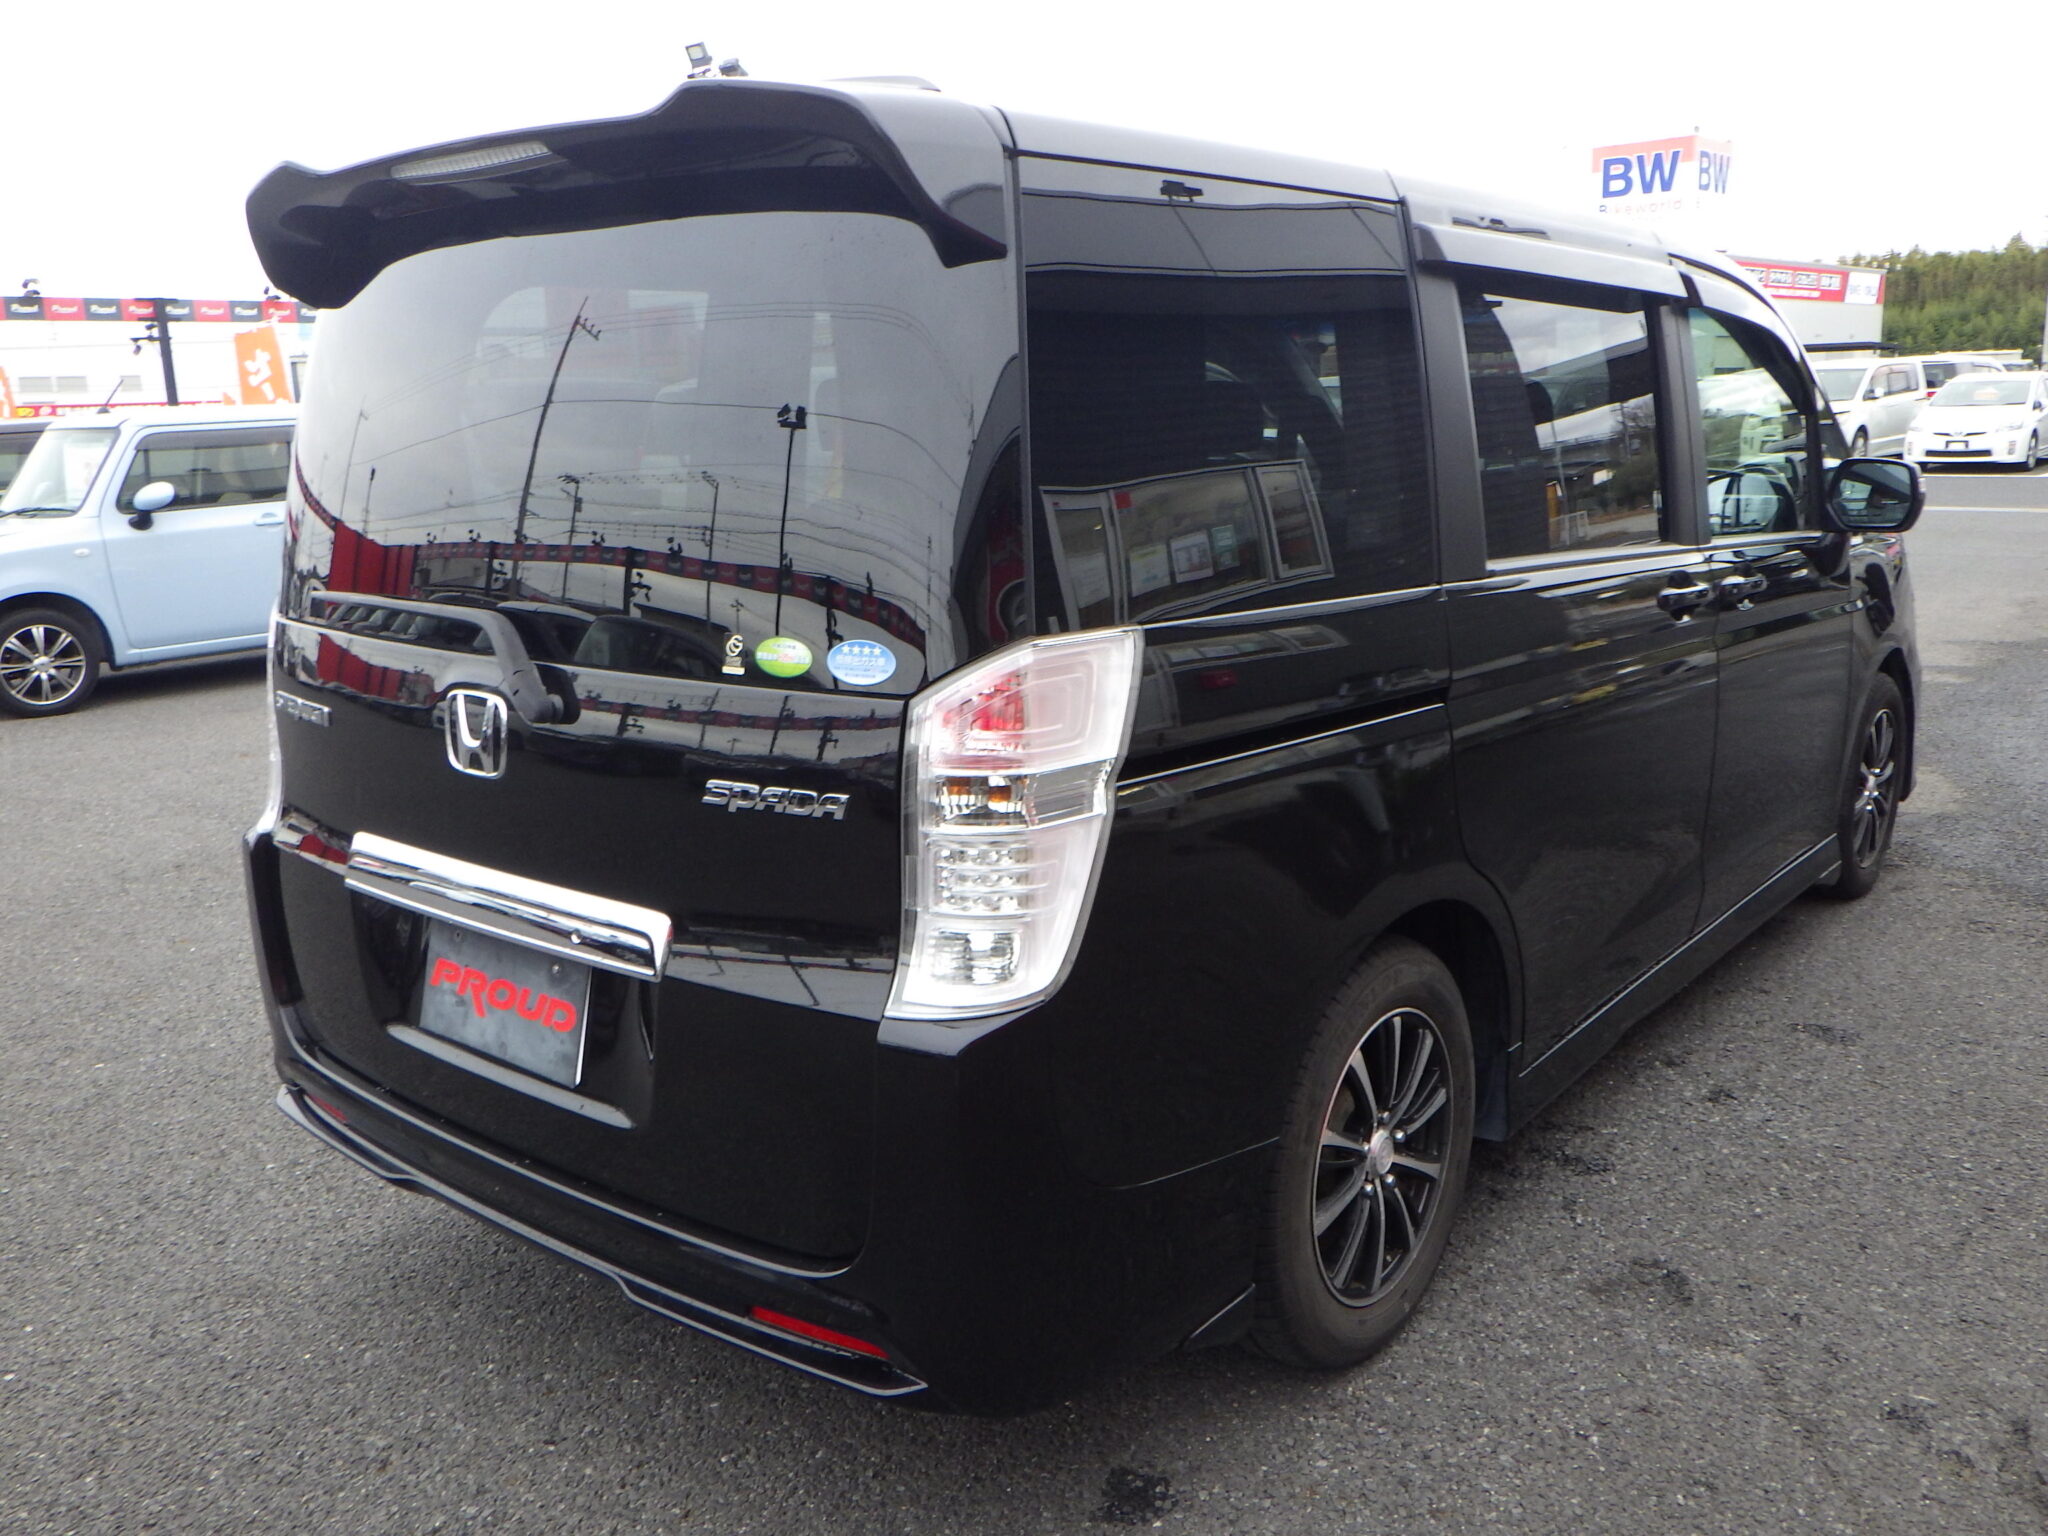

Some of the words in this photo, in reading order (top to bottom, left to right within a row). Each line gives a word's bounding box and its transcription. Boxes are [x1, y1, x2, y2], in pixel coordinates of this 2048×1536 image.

[1602, 150, 1681, 198] BW
[1698, 150, 1730, 194] BW
[701, 778, 850, 820] SPADA
[429, 957, 577, 1033] PROUD
